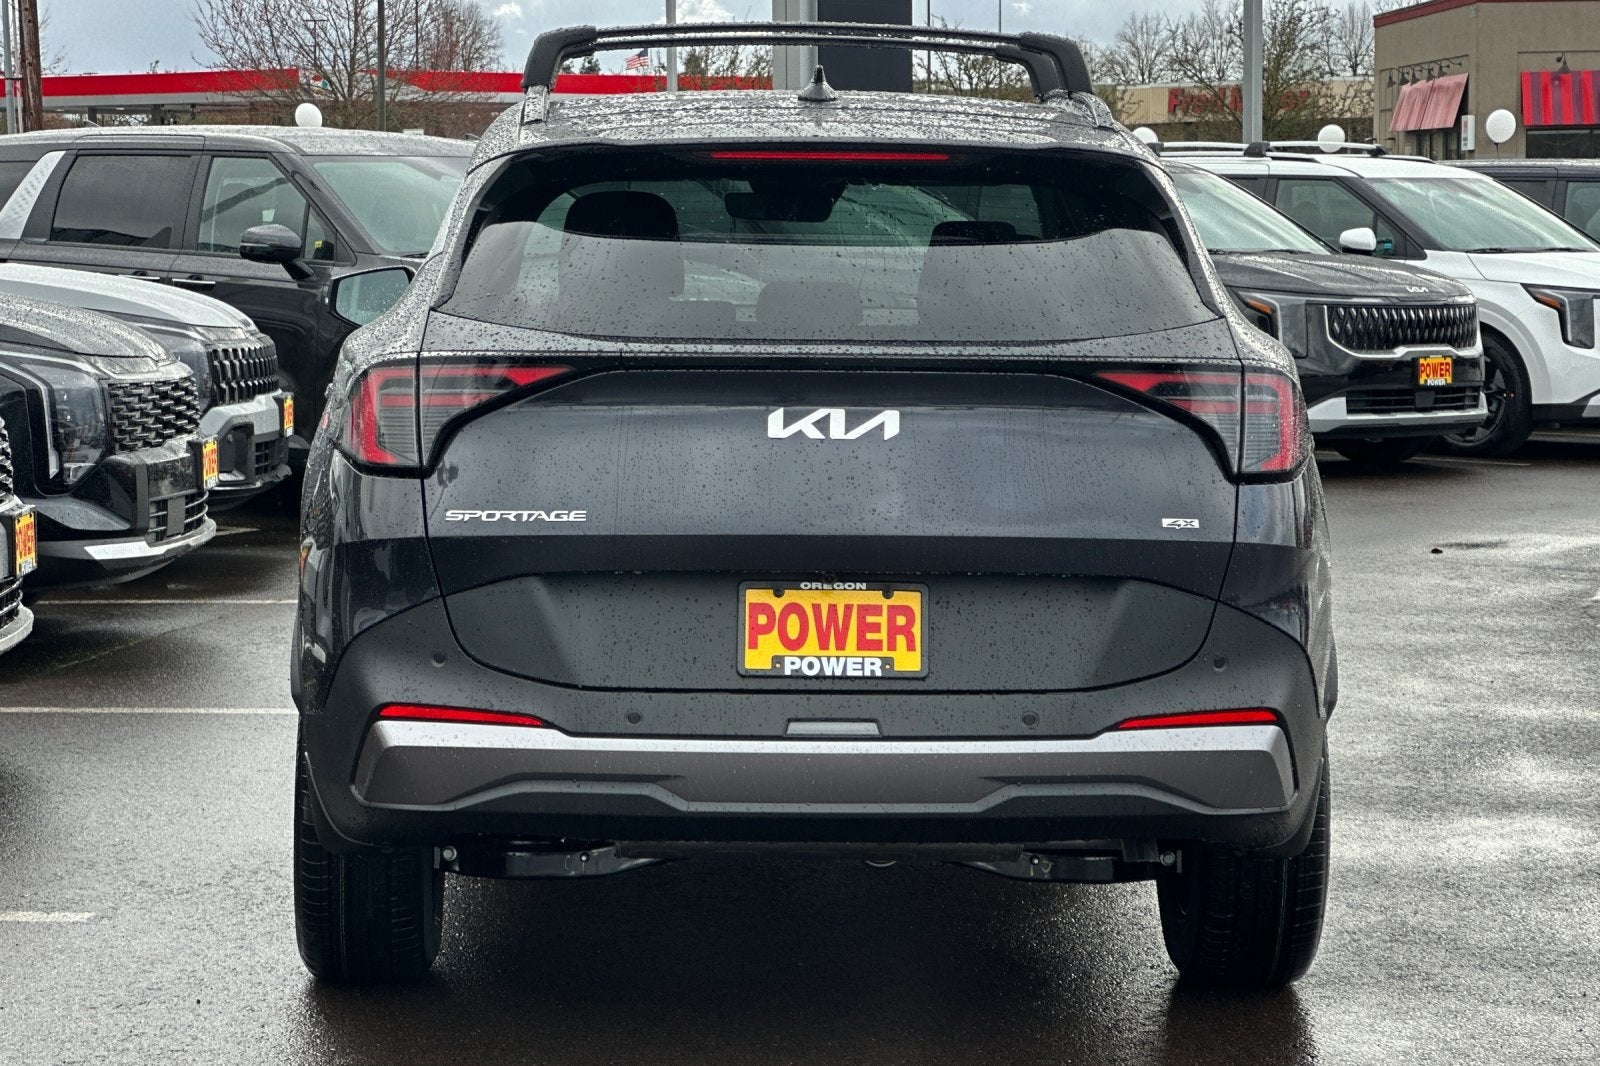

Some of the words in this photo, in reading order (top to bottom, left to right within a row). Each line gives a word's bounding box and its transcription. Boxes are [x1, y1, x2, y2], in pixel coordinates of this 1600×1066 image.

[1420, 362, 1450, 378] POWER
[767, 407, 900, 440] KIA
[445, 509, 587, 522] SPORTAGE
[800, 582, 867, 590] OREGON
[748, 602, 916, 652] POWER
[784, 656, 882, 677] POWER
